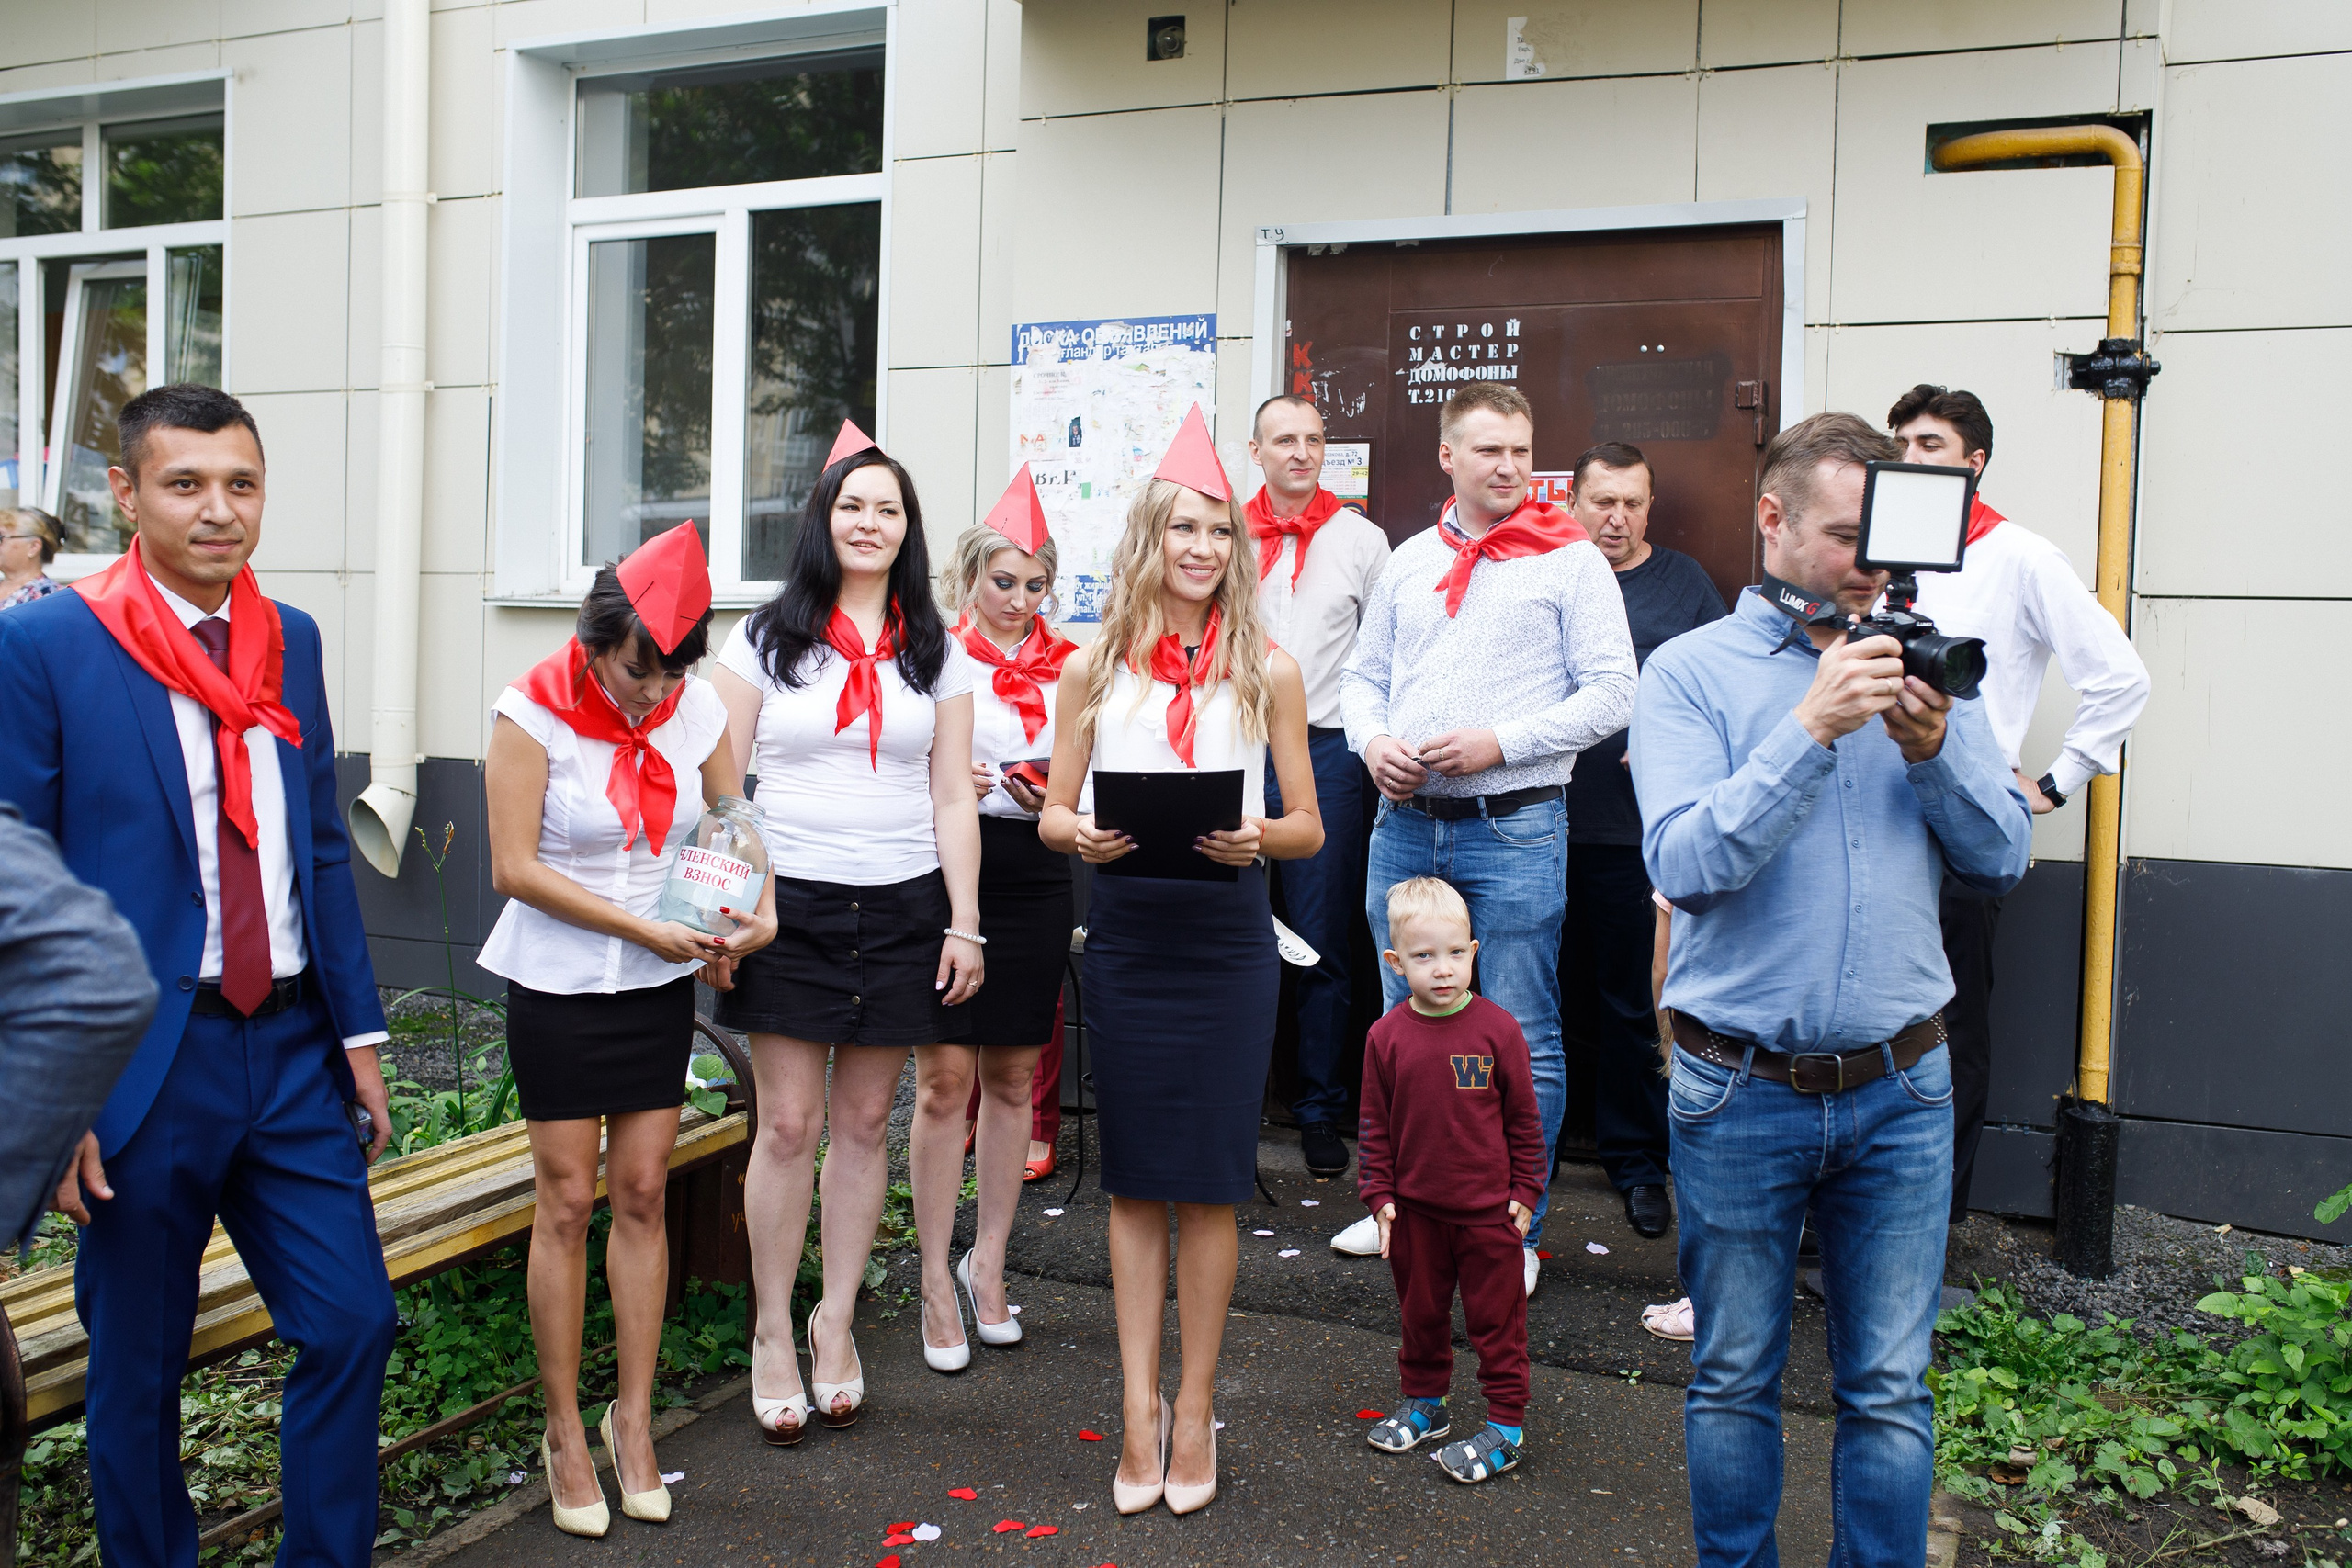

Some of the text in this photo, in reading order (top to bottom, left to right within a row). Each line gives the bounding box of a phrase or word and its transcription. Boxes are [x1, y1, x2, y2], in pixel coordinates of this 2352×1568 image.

[1409, 318, 1521, 341] СТРОЙ
[1408, 343, 1520, 362] МАСТЕР
[1408, 365, 1519, 386] ДОМОФОНЫ
[1357, 457, 1363, 466] 3
[1779, 587, 1821, 615] LUMIX G
[680, 848, 751, 880] ЧЛЕНСКИЙ
[683, 866, 732, 891] ВЗНОС
